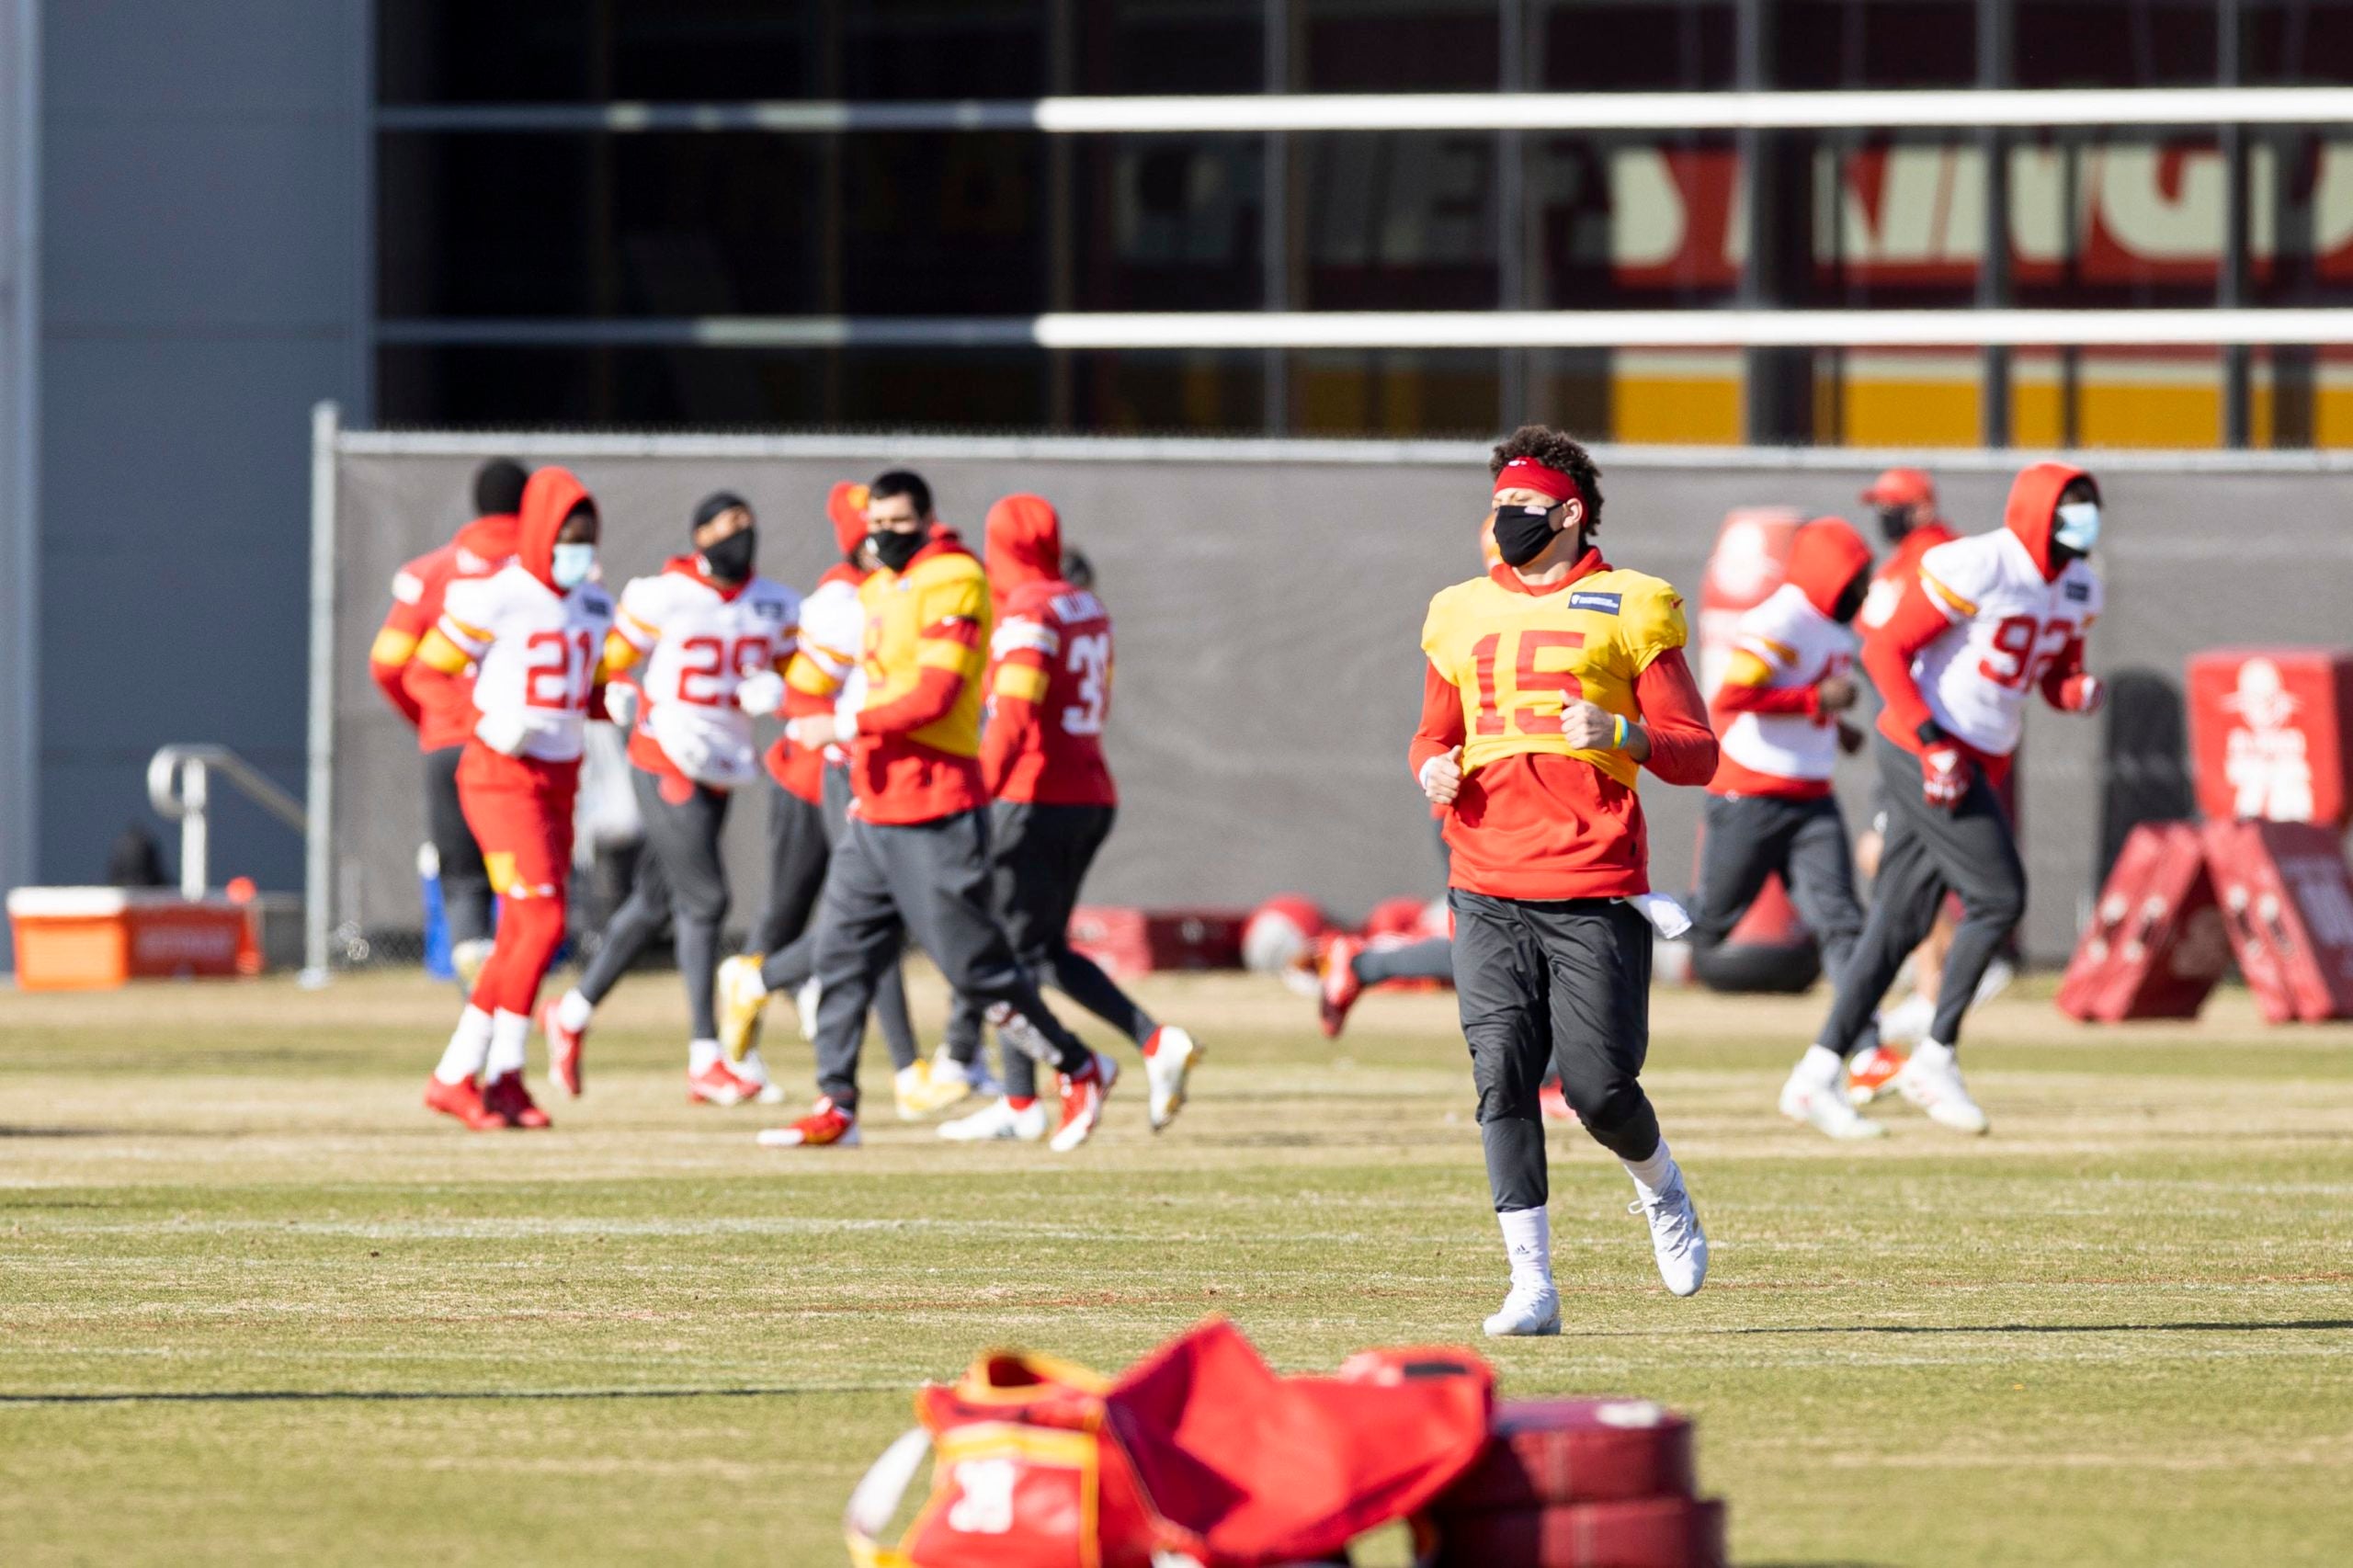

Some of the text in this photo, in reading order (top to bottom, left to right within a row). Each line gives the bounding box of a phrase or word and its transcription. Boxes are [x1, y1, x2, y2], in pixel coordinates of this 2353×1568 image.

[526, 631, 593, 709] 21
[1471, 630, 1586, 735] 15
[1978, 614, 2075, 694] 92
